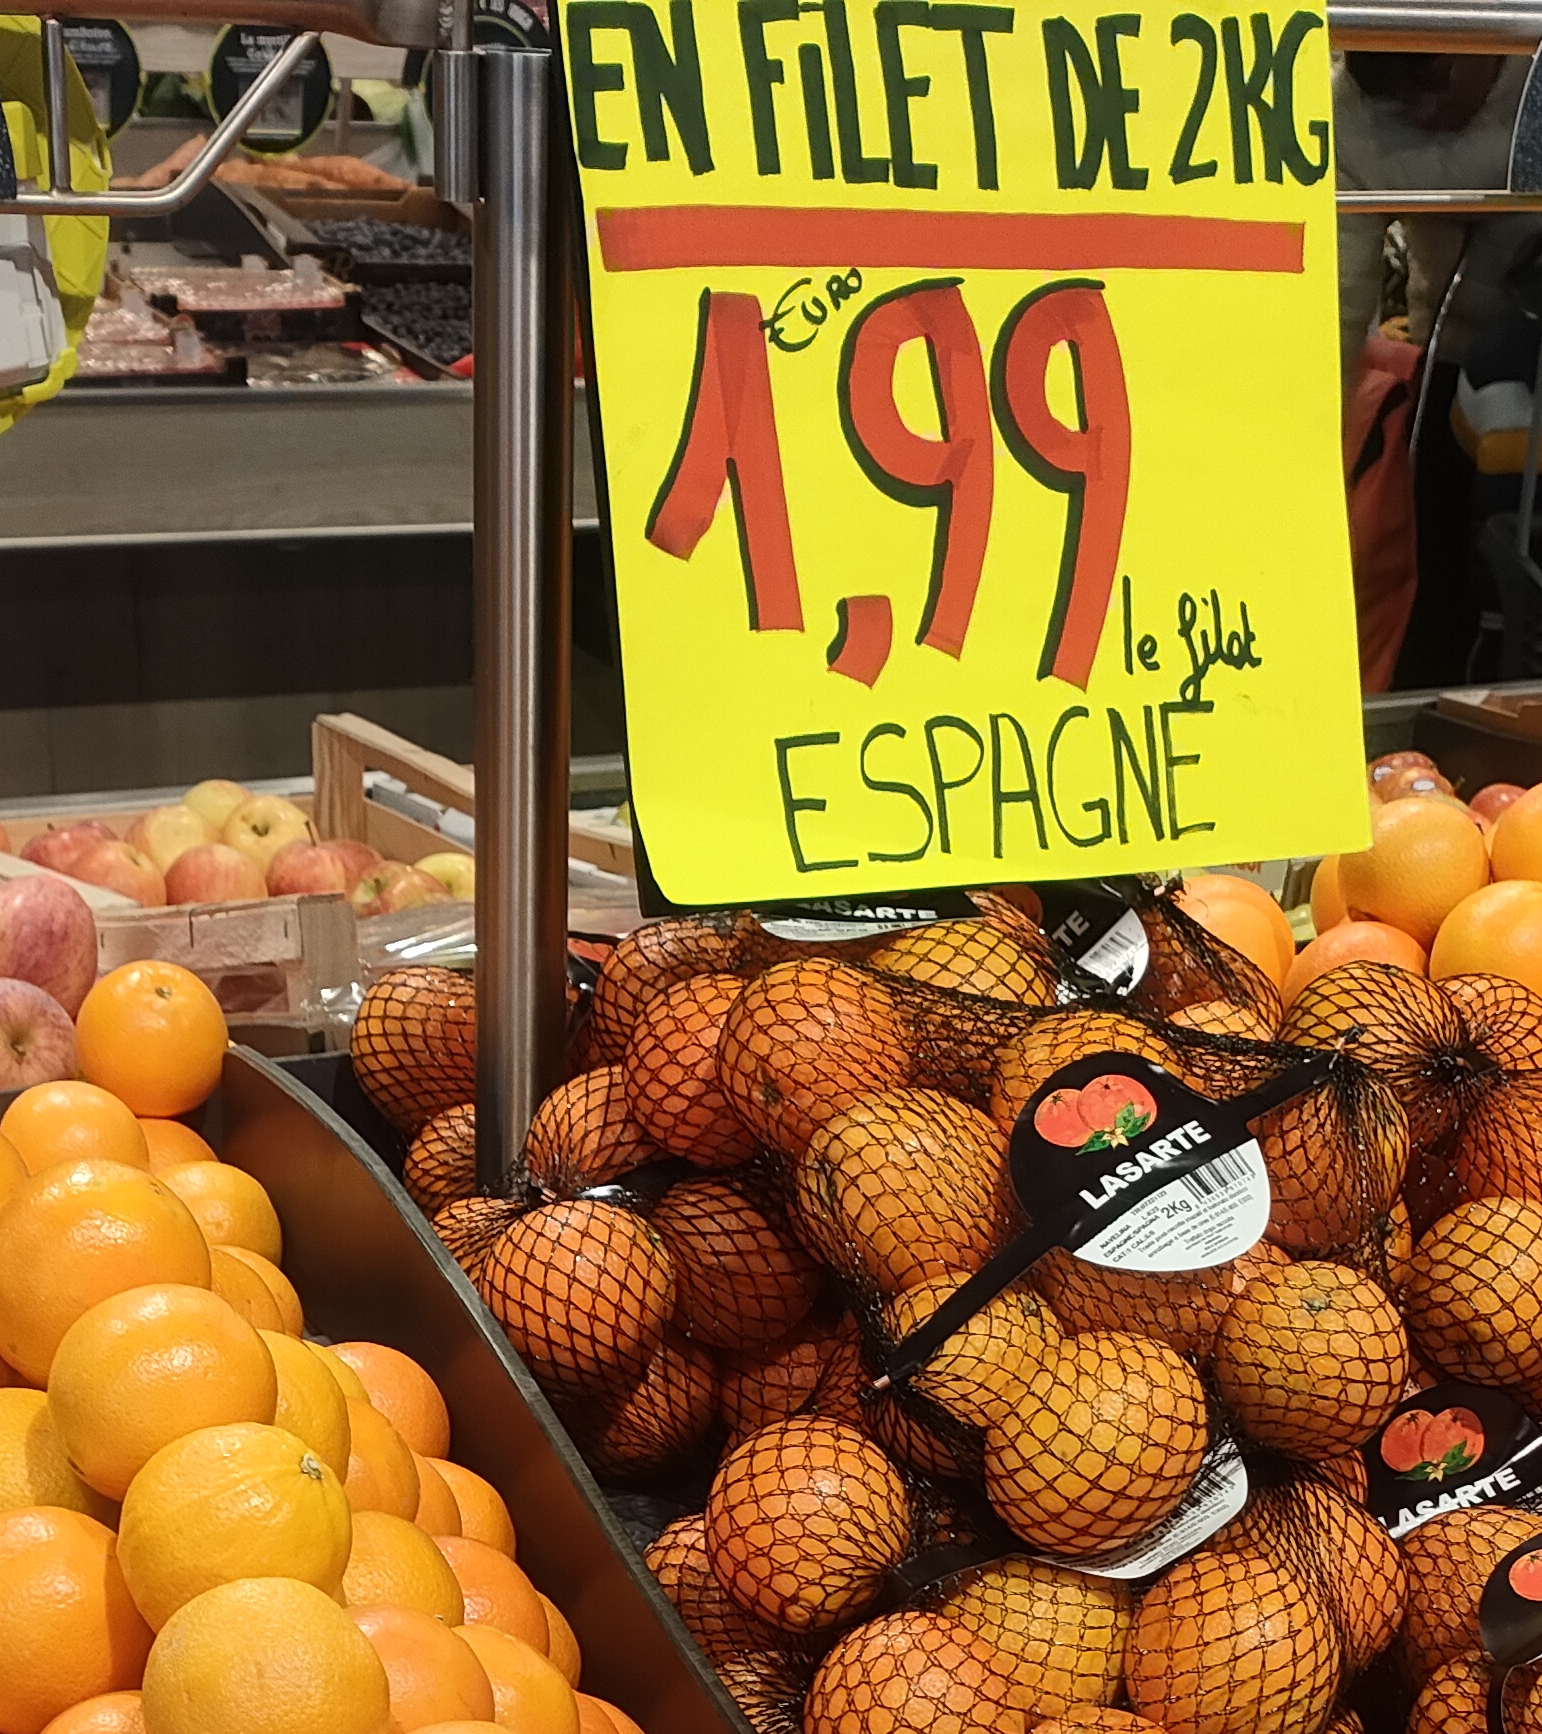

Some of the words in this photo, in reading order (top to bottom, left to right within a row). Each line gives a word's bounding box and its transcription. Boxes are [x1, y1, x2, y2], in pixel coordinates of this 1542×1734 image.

[565, 0, 715, 177] EN
[1042, 11, 1149, 191] DE
[1170, 9, 1330, 186] 2KG
[1121, 575, 1160, 676] le
[775, 699, 1216, 873] ESPAGNE
[1079, 1120, 1211, 1210] LASARTE
[1160, 1199, 1193, 1220] 2Kg
